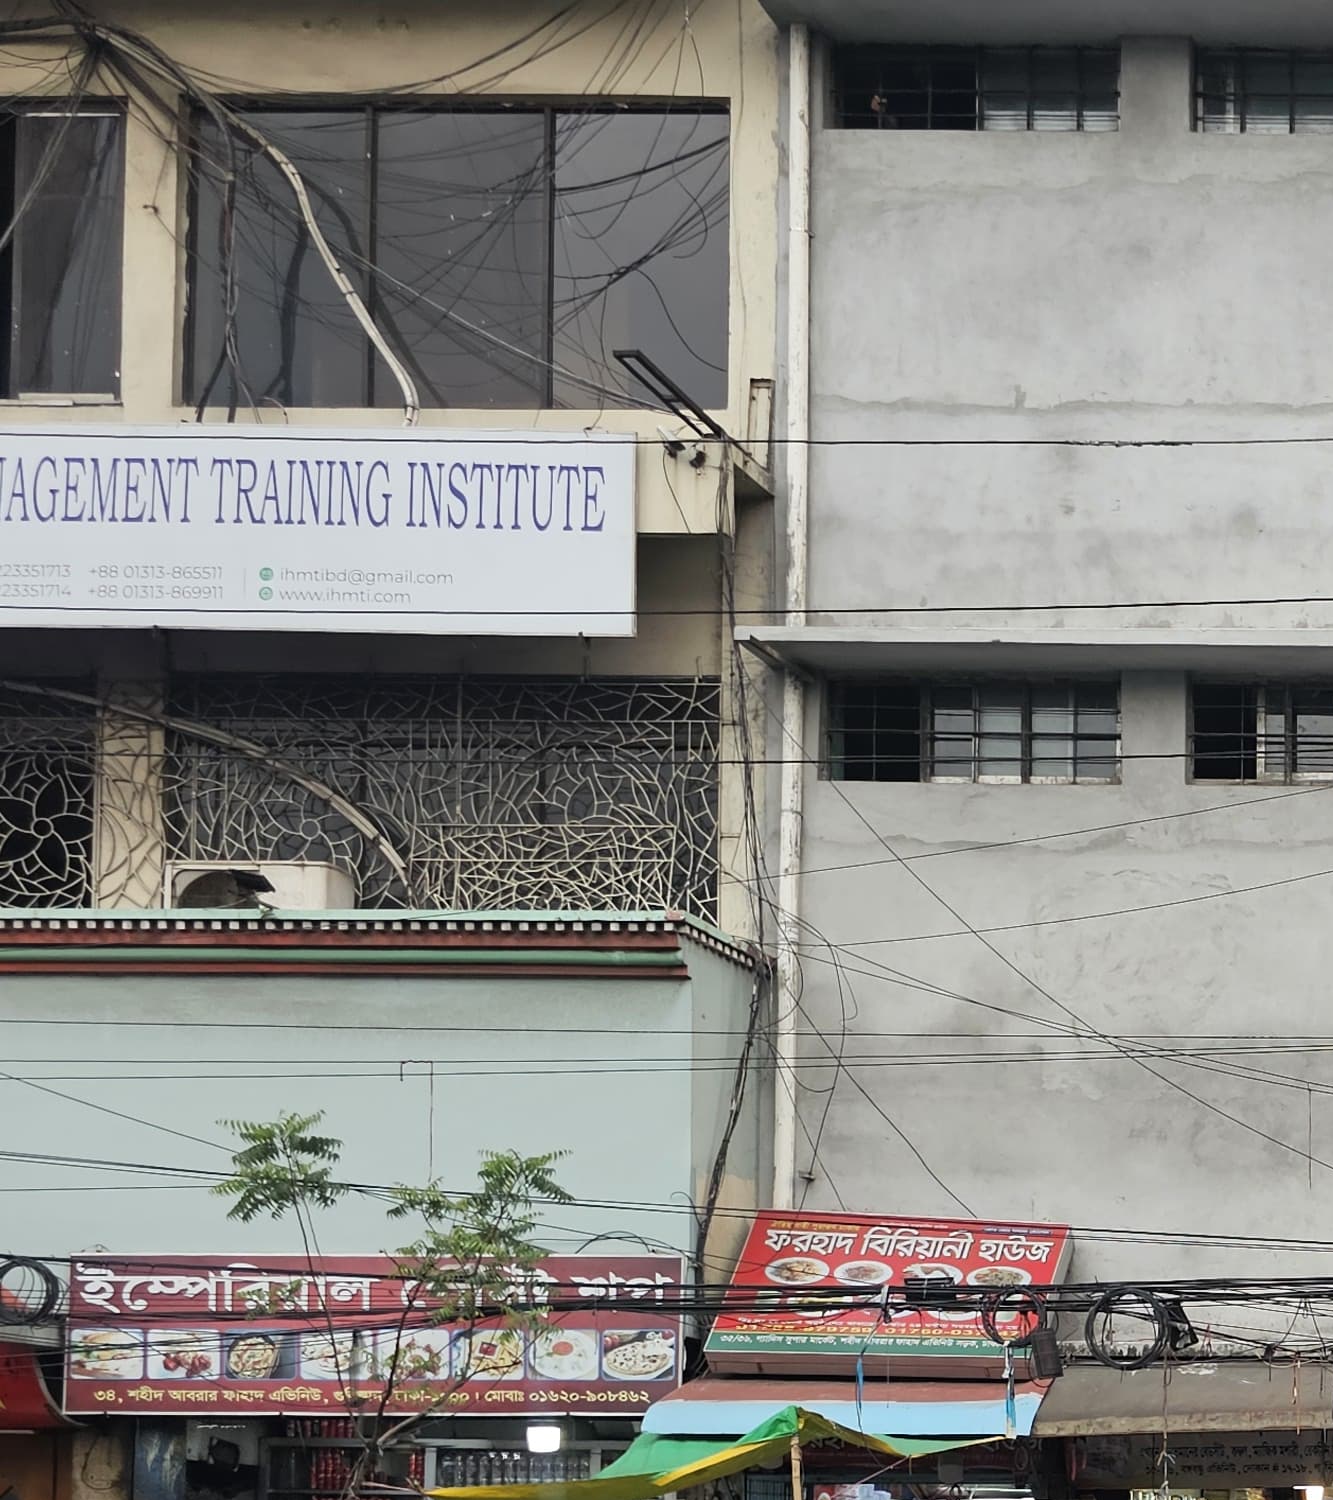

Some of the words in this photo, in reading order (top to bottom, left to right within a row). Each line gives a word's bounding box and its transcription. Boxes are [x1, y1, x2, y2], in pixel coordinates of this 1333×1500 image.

[210, 456, 392, 528] TRAINING
[406, 461, 606, 532] INSTITUTE
[0, 564, 72, 578] 23351713
[123, 564, 223, 580] 01313-865511
[280, 568, 453, 585] ihmtibd@gmail.com
[122, 584, 223, 600] 01313-869911
[280, 588, 411, 604] www.ihmti.com
[764, 1228, 858, 1256] ফরহাদ
[860, 1226, 975, 1261] বিরিয়ানী
[977, 1235, 1054, 1264] হাউজ
